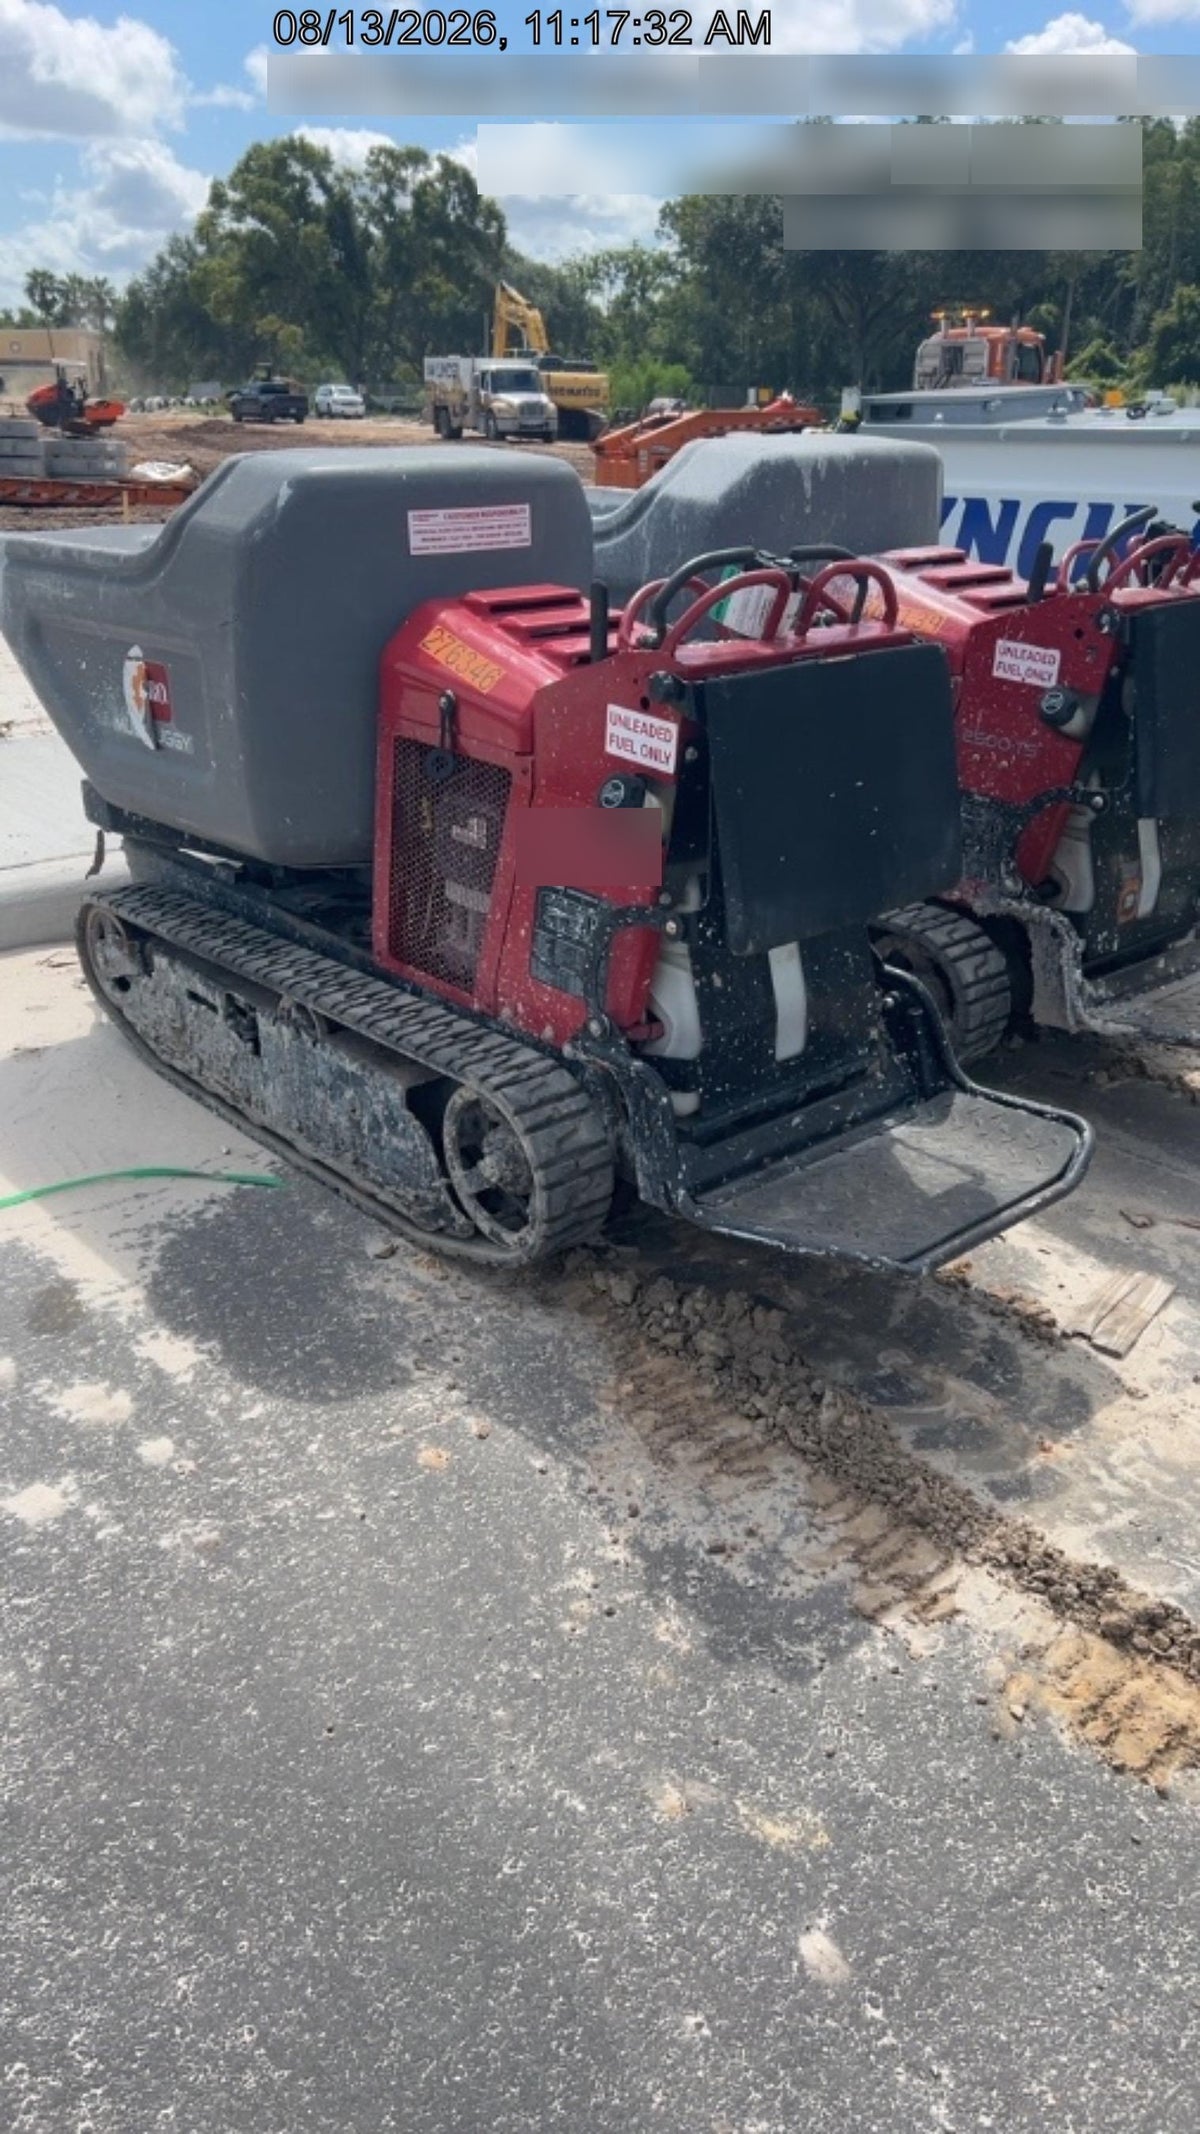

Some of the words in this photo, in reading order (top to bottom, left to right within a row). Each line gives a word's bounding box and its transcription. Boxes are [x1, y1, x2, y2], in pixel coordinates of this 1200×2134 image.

[999, 644, 1056, 665] UNLEADED
[996, 660, 1022, 677] FUEL
[1024, 666, 1054, 683] ONLY
[609, 710, 673, 743] UNLEADED
[609, 732, 637, 755] FUEL
[640, 744, 672, 766] ONLY
